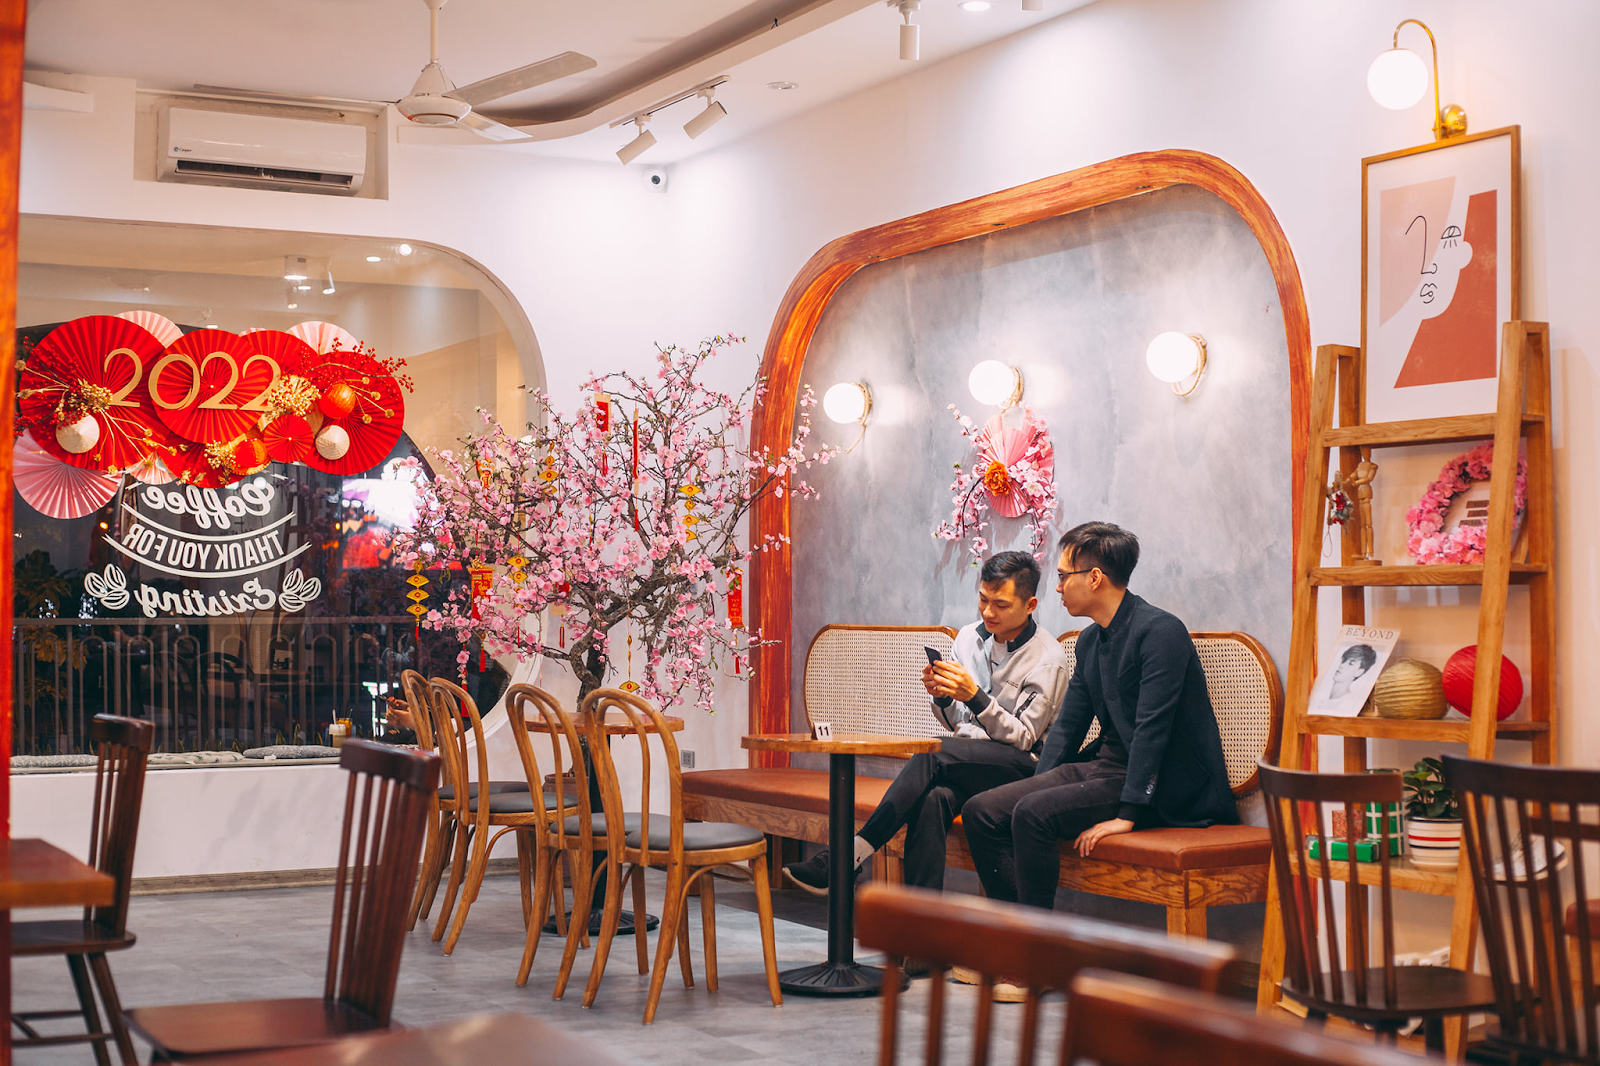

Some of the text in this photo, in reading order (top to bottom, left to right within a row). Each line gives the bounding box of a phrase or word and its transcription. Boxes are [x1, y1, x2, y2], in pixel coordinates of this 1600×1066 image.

[103, 347, 282, 412] 2022
[1346, 627, 1394, 640] BEYOND
[818, 725, 829, 736] 11
